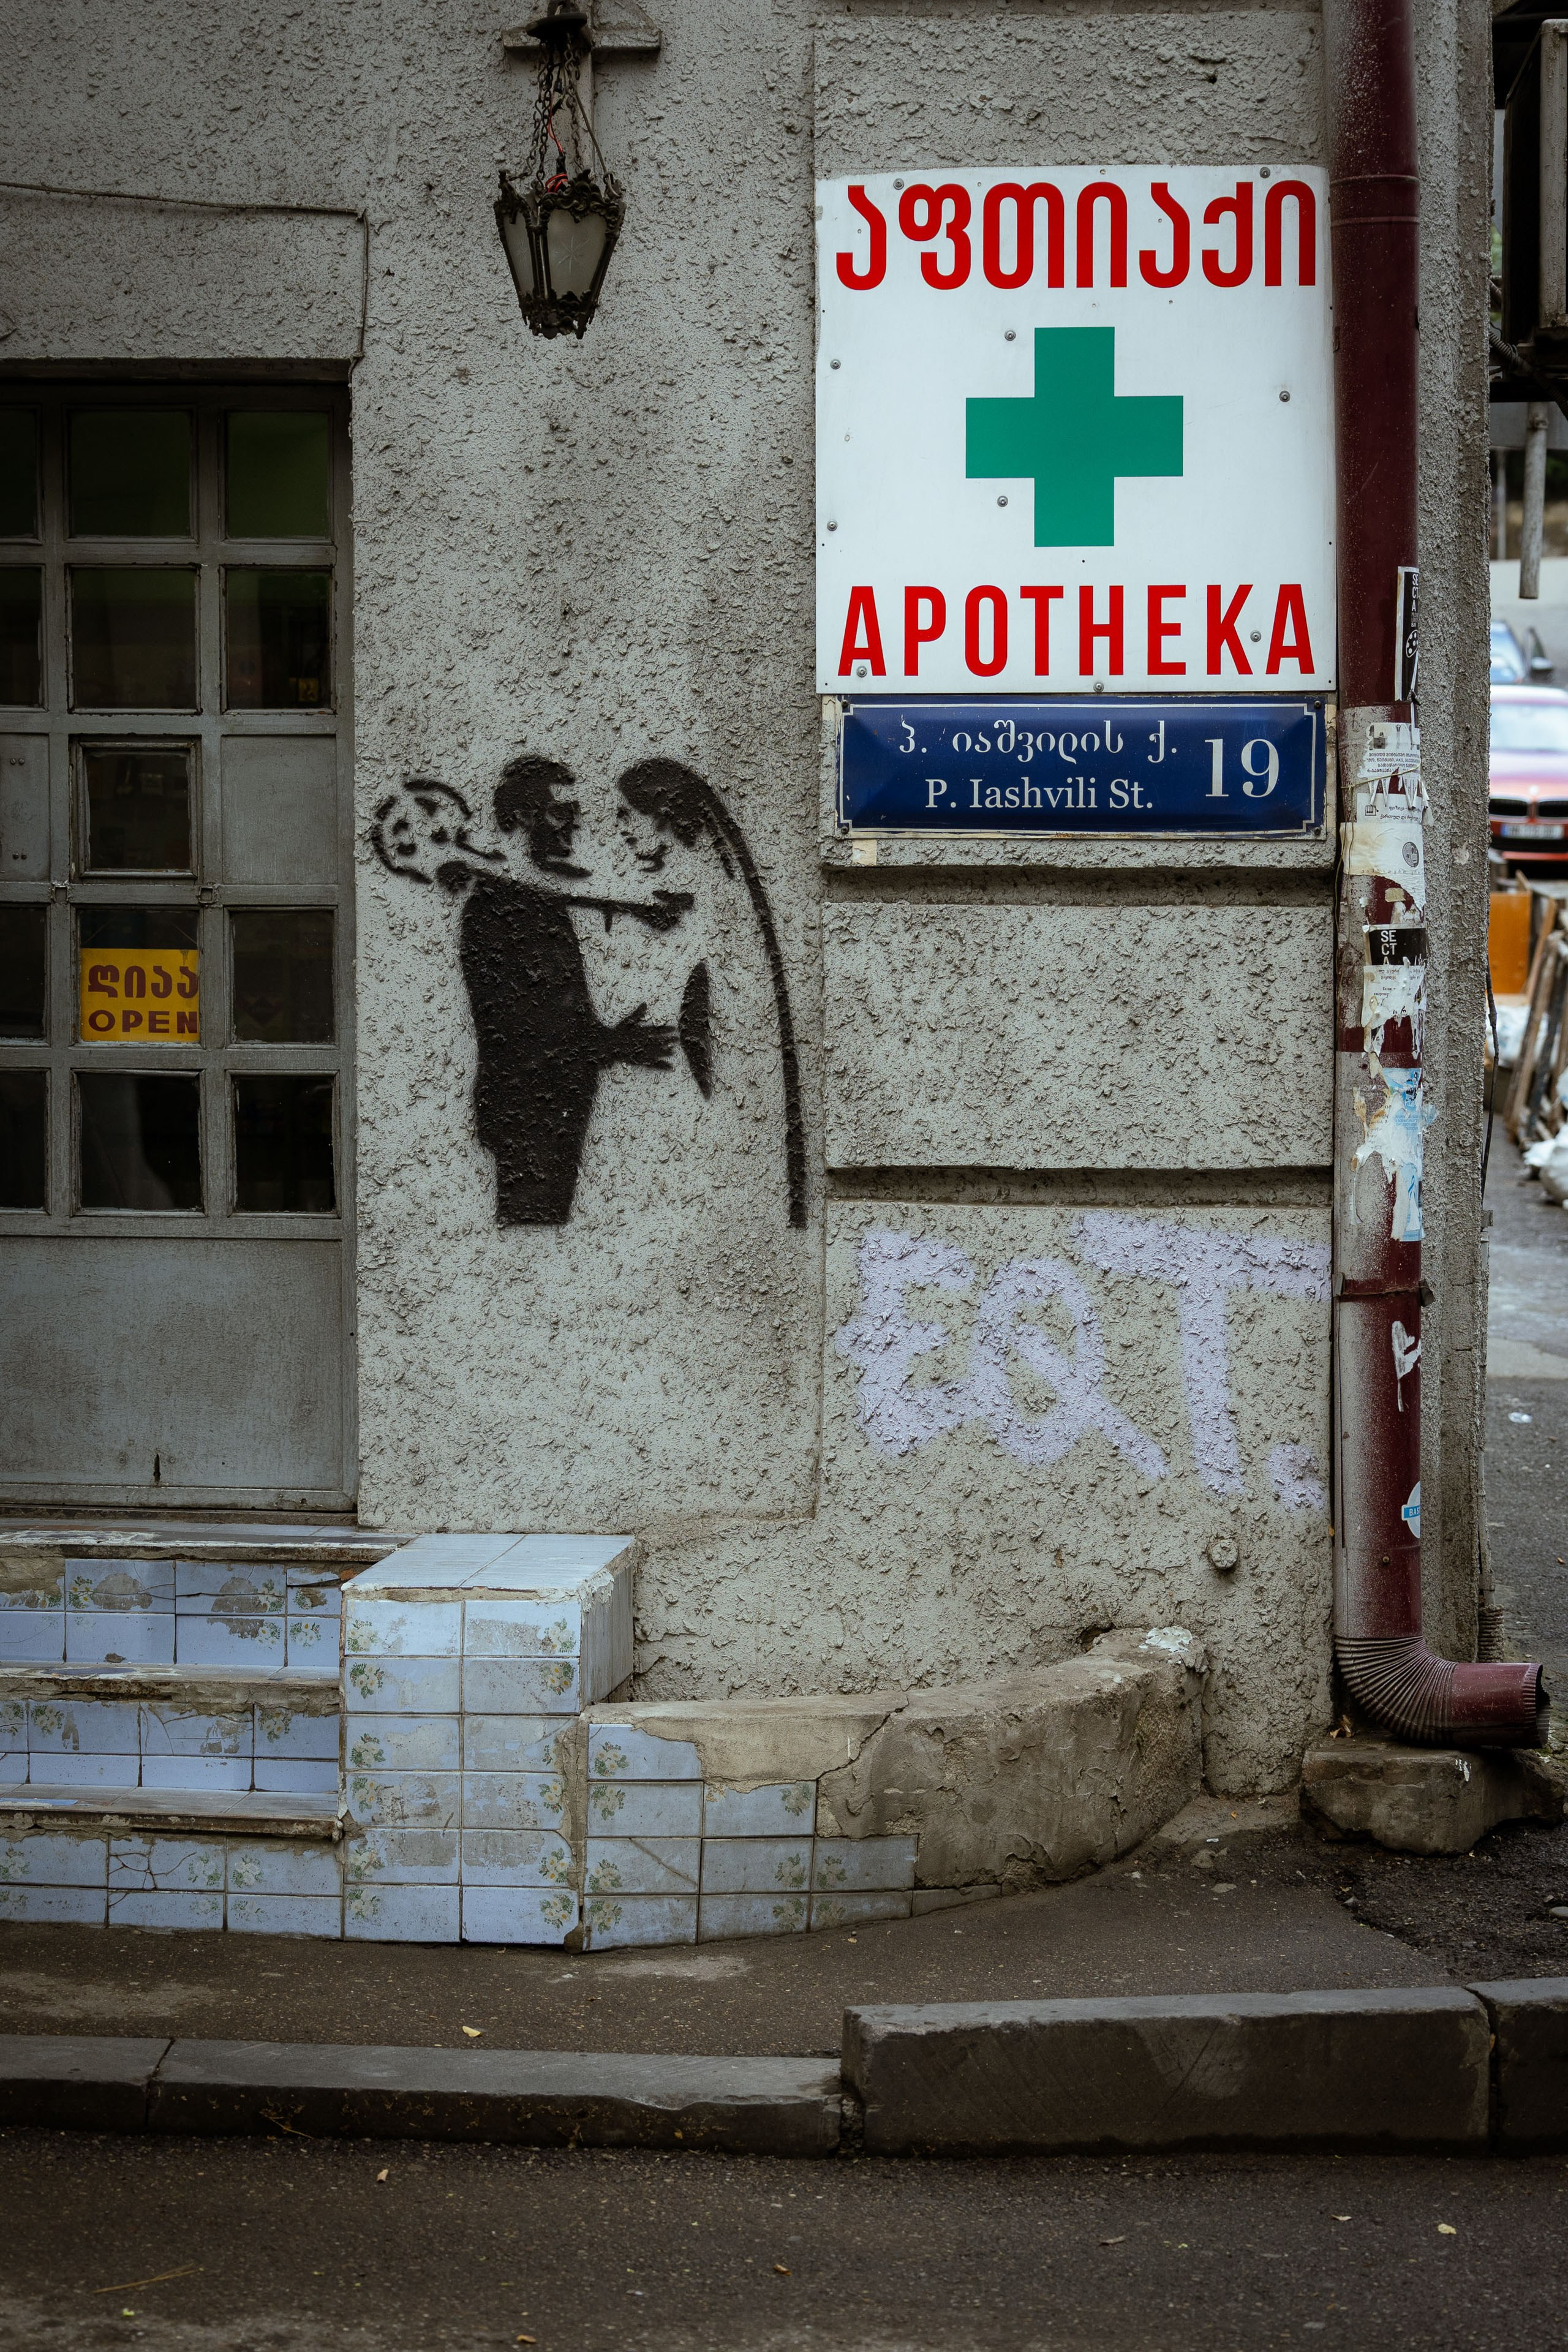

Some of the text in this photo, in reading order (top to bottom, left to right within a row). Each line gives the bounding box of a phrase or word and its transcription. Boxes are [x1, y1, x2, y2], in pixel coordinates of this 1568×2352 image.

[836, 180, 1316, 291] აფთიაქი
[837, 584, 1316, 677] APOTHEKA
[899, 719, 1177, 764] პ. იაშვილის ქ.
[1204, 738, 1280, 797] 19
[925, 777, 1153, 809] P. Iashvili St.
[1381, 930, 1396, 943] SE
[1381, 943, 1396, 956] CT
[88, 964, 198, 999] ღიაა
[88, 1009, 198, 1034] OPEN
